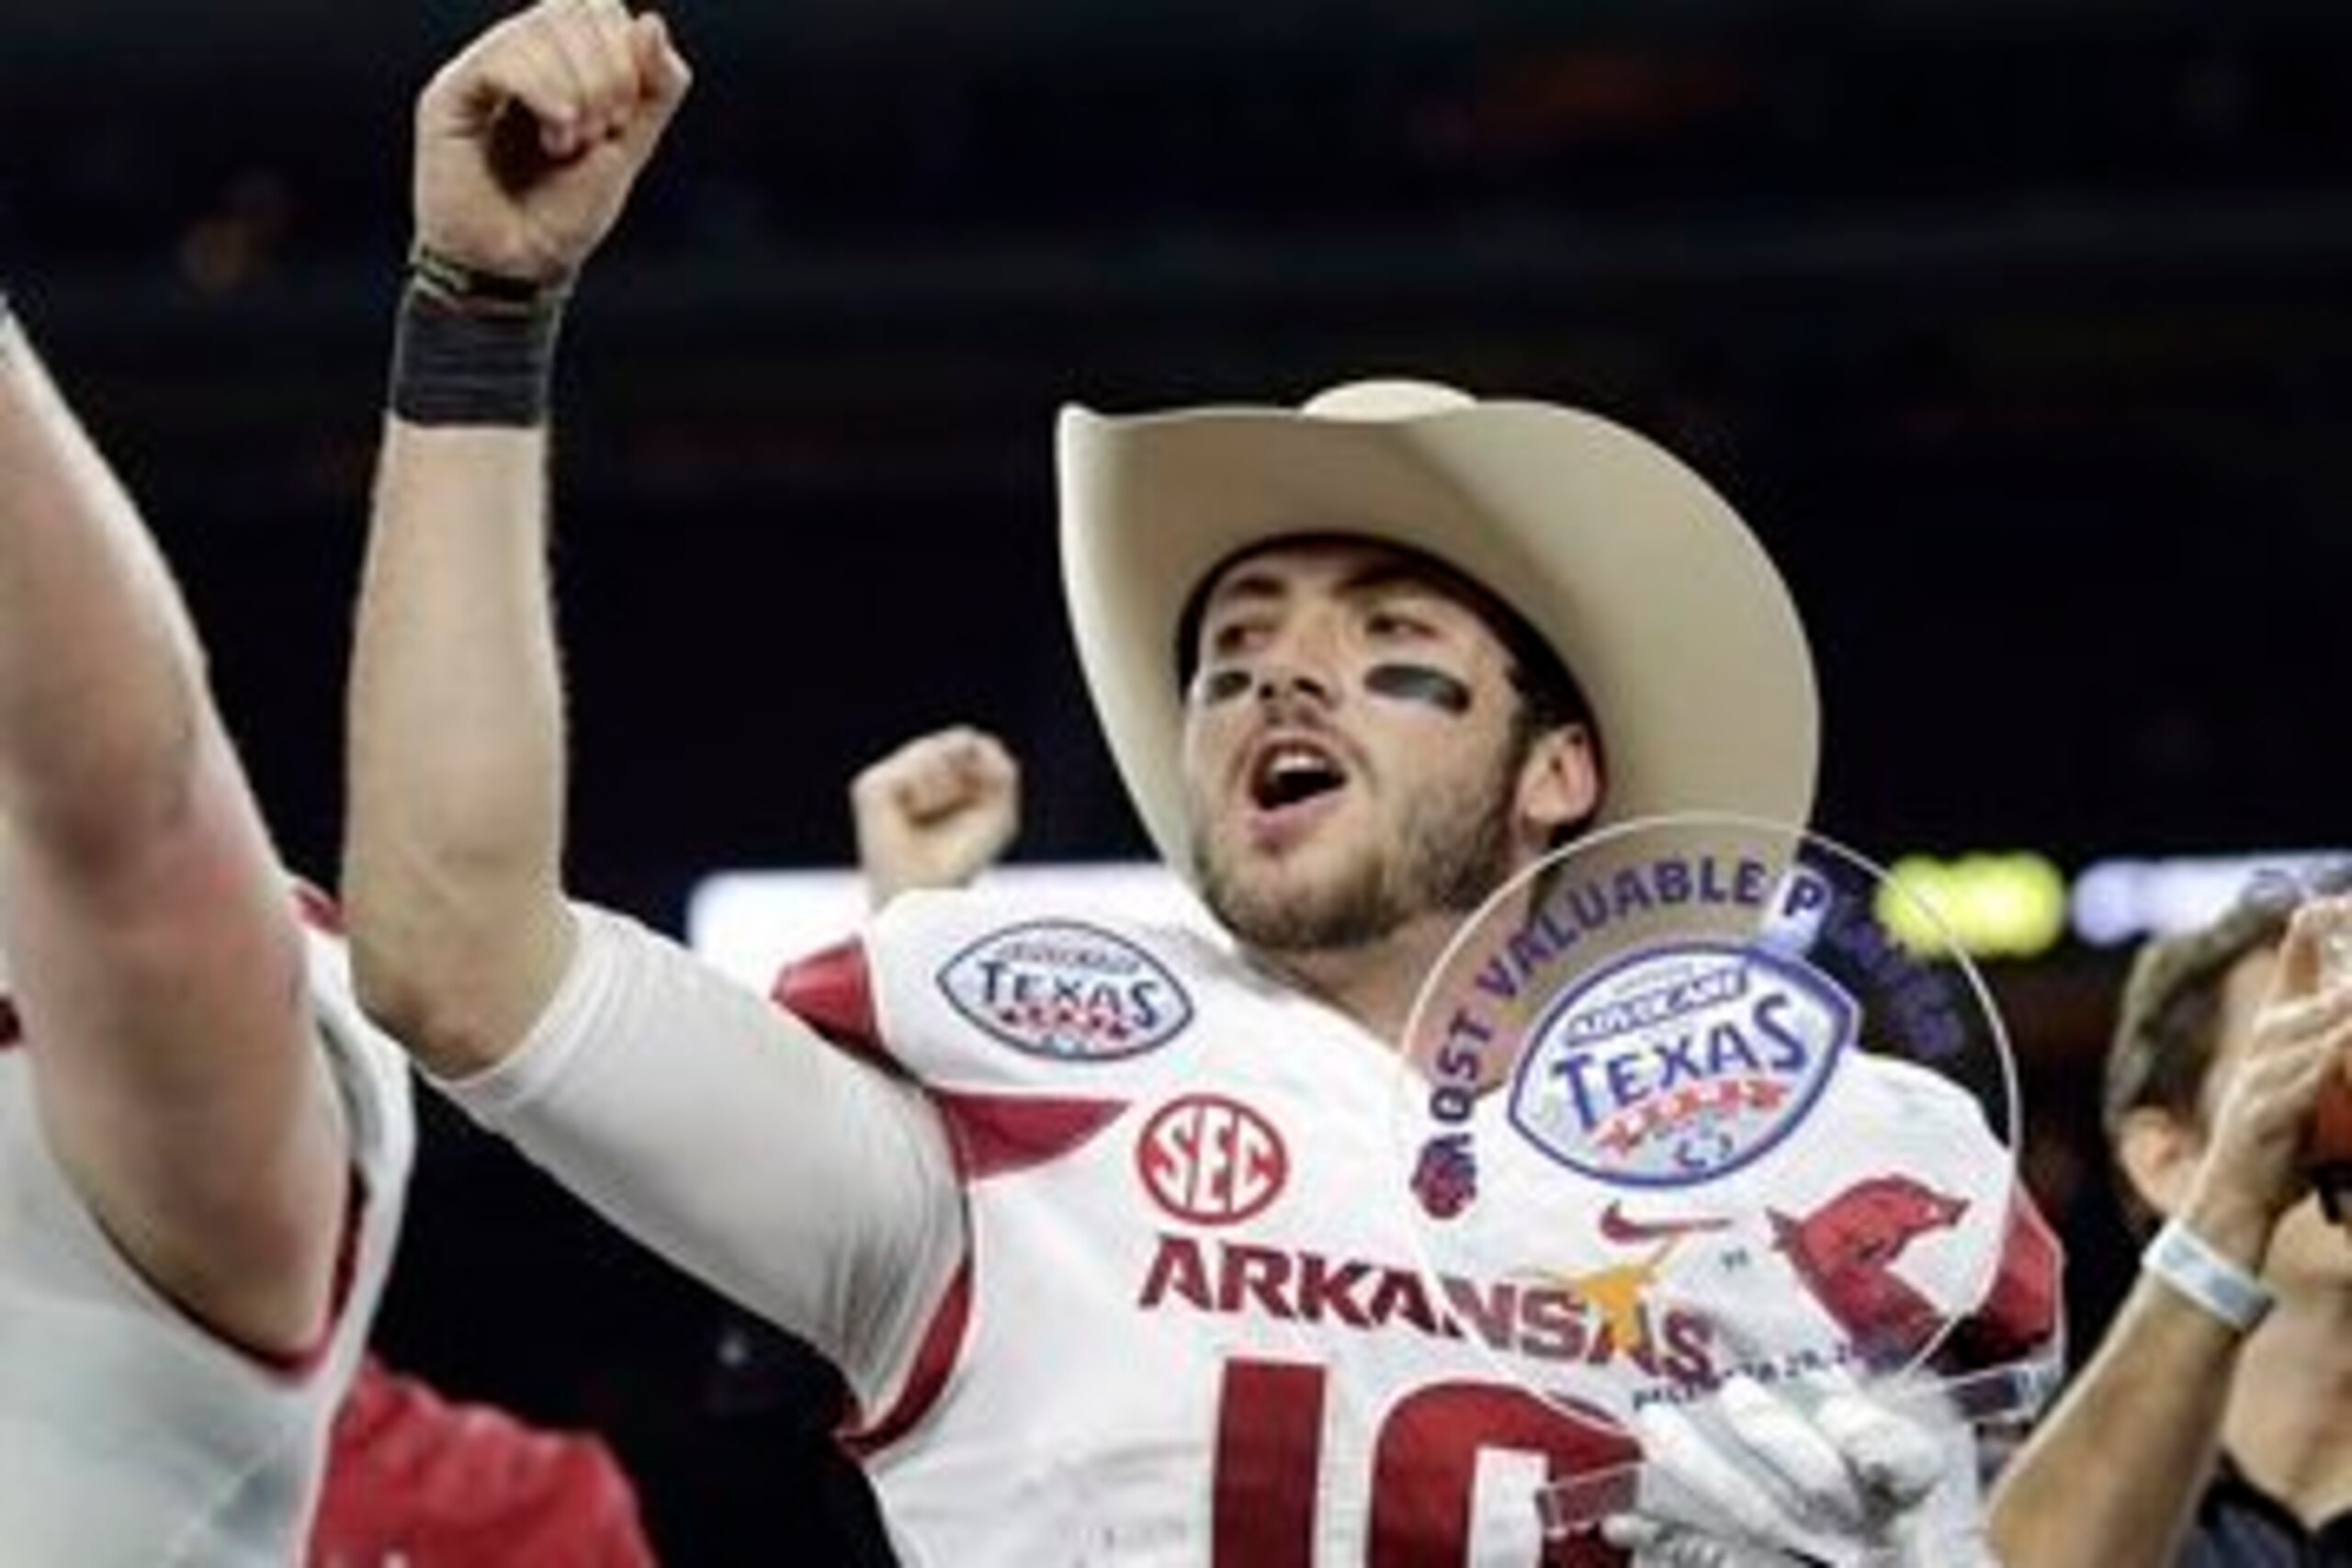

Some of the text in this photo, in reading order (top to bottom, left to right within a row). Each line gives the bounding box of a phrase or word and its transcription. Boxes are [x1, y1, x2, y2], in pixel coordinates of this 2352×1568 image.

[978, 962, 1158, 1028] TEXAS
[1476, 858, 1766, 997] VALUABLE
[1553, 994, 1807, 1131] TEXAS
[1139, 1095, 1287, 1224] SEC
[1139, 1234, 1715, 1390] ARKANSAS
